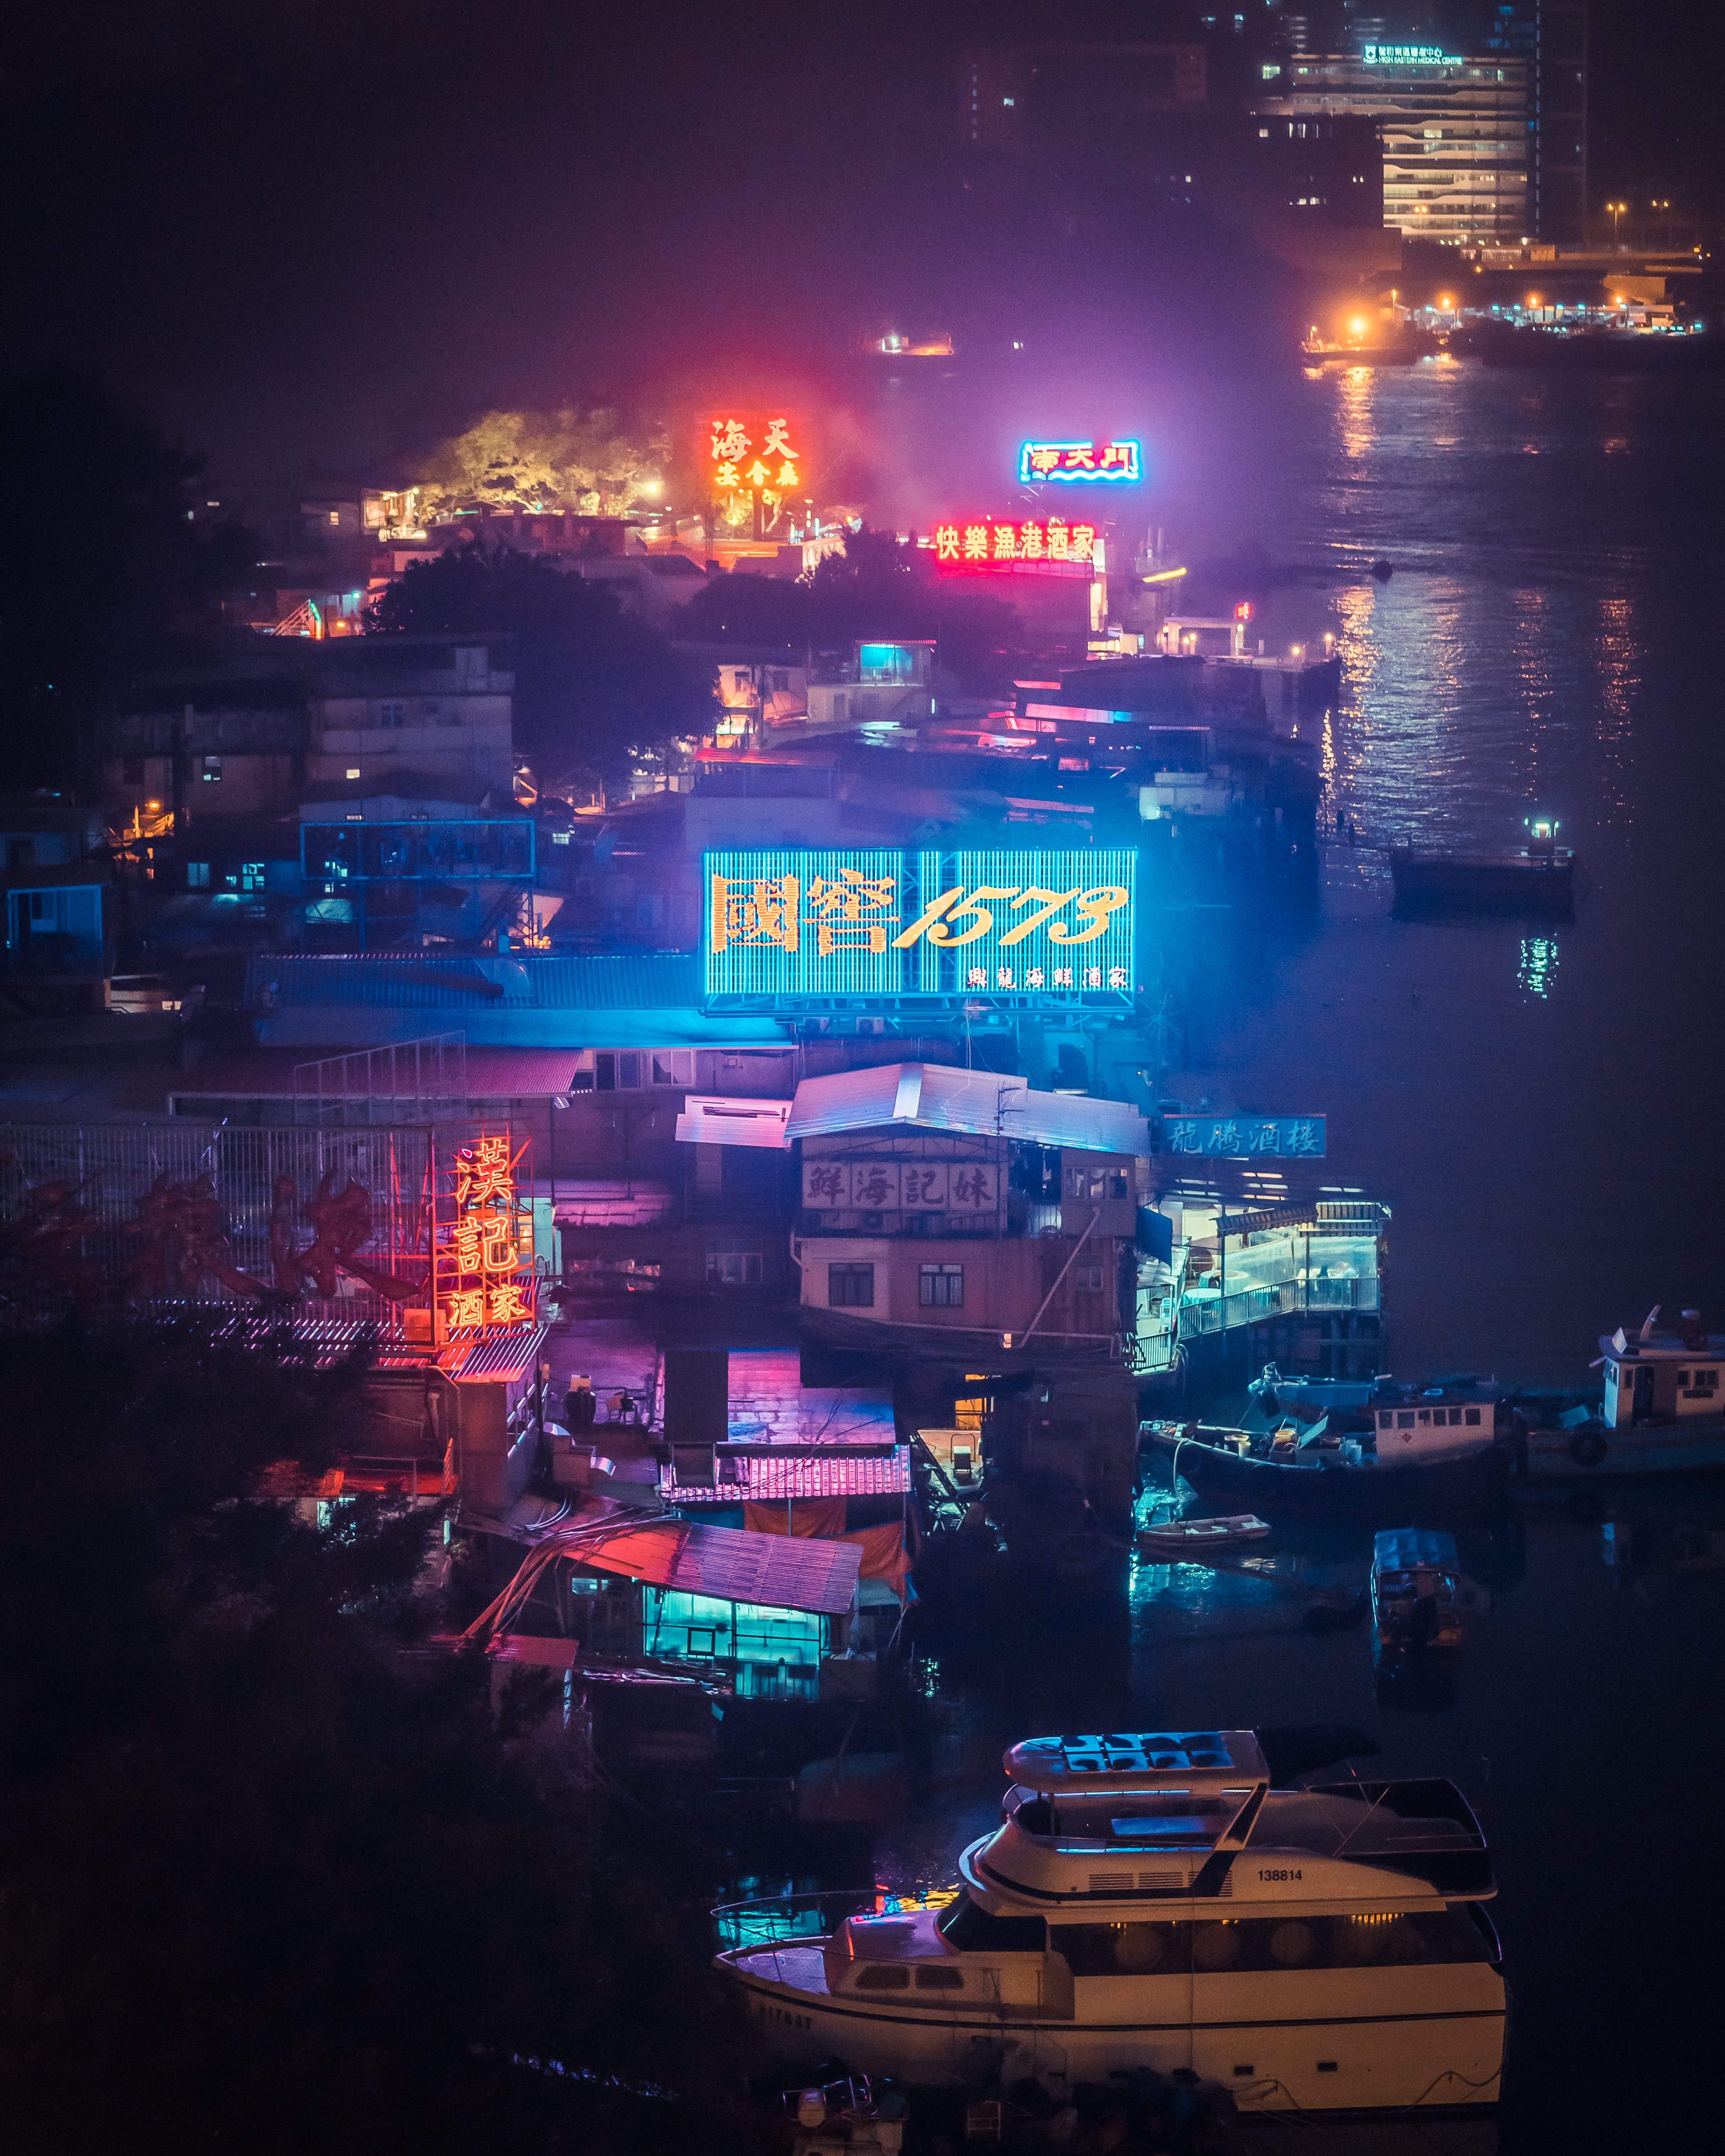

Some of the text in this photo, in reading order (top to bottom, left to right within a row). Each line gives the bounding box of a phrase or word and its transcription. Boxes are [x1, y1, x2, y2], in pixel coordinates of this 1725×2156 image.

[1418, 57, 1441, 65] MEDICAL
[711, 418, 800, 462] 海天
[936, 524, 1094, 559] 快樂漁港酒家
[891, 885, 1129, 948] 1573
[967, 966, 1128, 988] 興龍海鮮酒家
[1168, 1119, 1319, 1154] 龍騰酒樓
[1257, 1869, 1303, 1881] 138814
